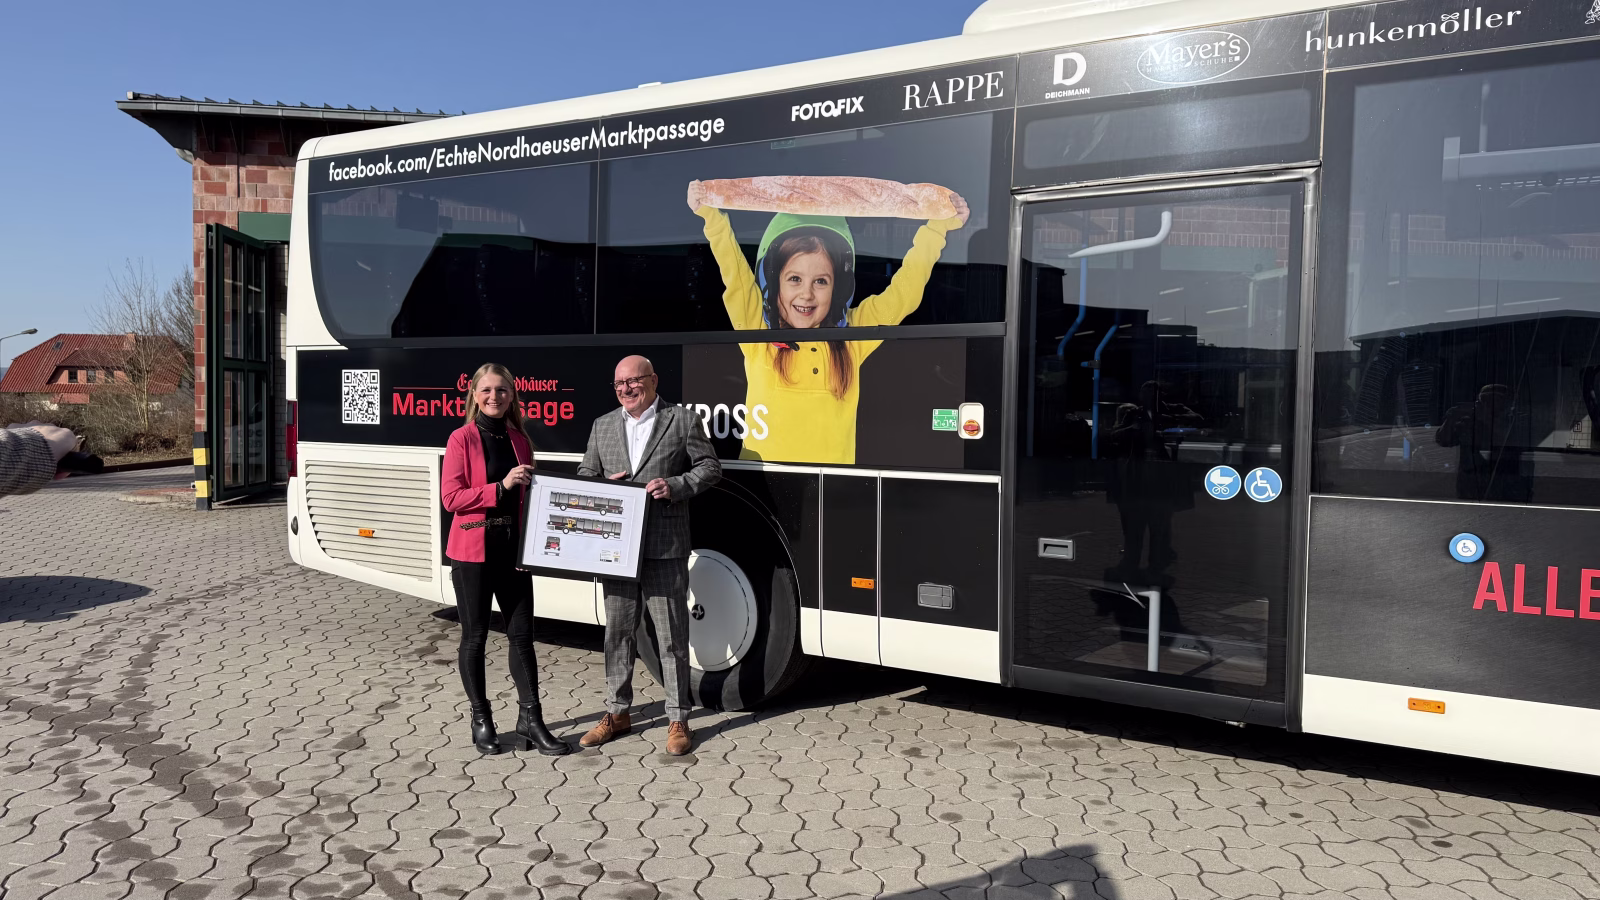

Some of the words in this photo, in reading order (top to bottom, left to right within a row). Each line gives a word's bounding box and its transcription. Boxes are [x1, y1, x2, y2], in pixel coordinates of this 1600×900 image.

[1146, 32, 1241, 68] Mayer's
[1194, 56, 1234, 66] SCHUHE
[1053, 51, 1087, 86] D
[902, 70, 1005, 111] RAPPE
[1045, 87, 1091, 99] DEICHMANN
[791, 95, 865, 122] FOTOFIX
[328, 117, 726, 182] facebook.com/EchteNordhaeuserMarktpassage
[392, 392, 575, 427] Marktsage
[677, 403, 769, 441] ROSS
[1472, 561, 1600, 621] ALLE
